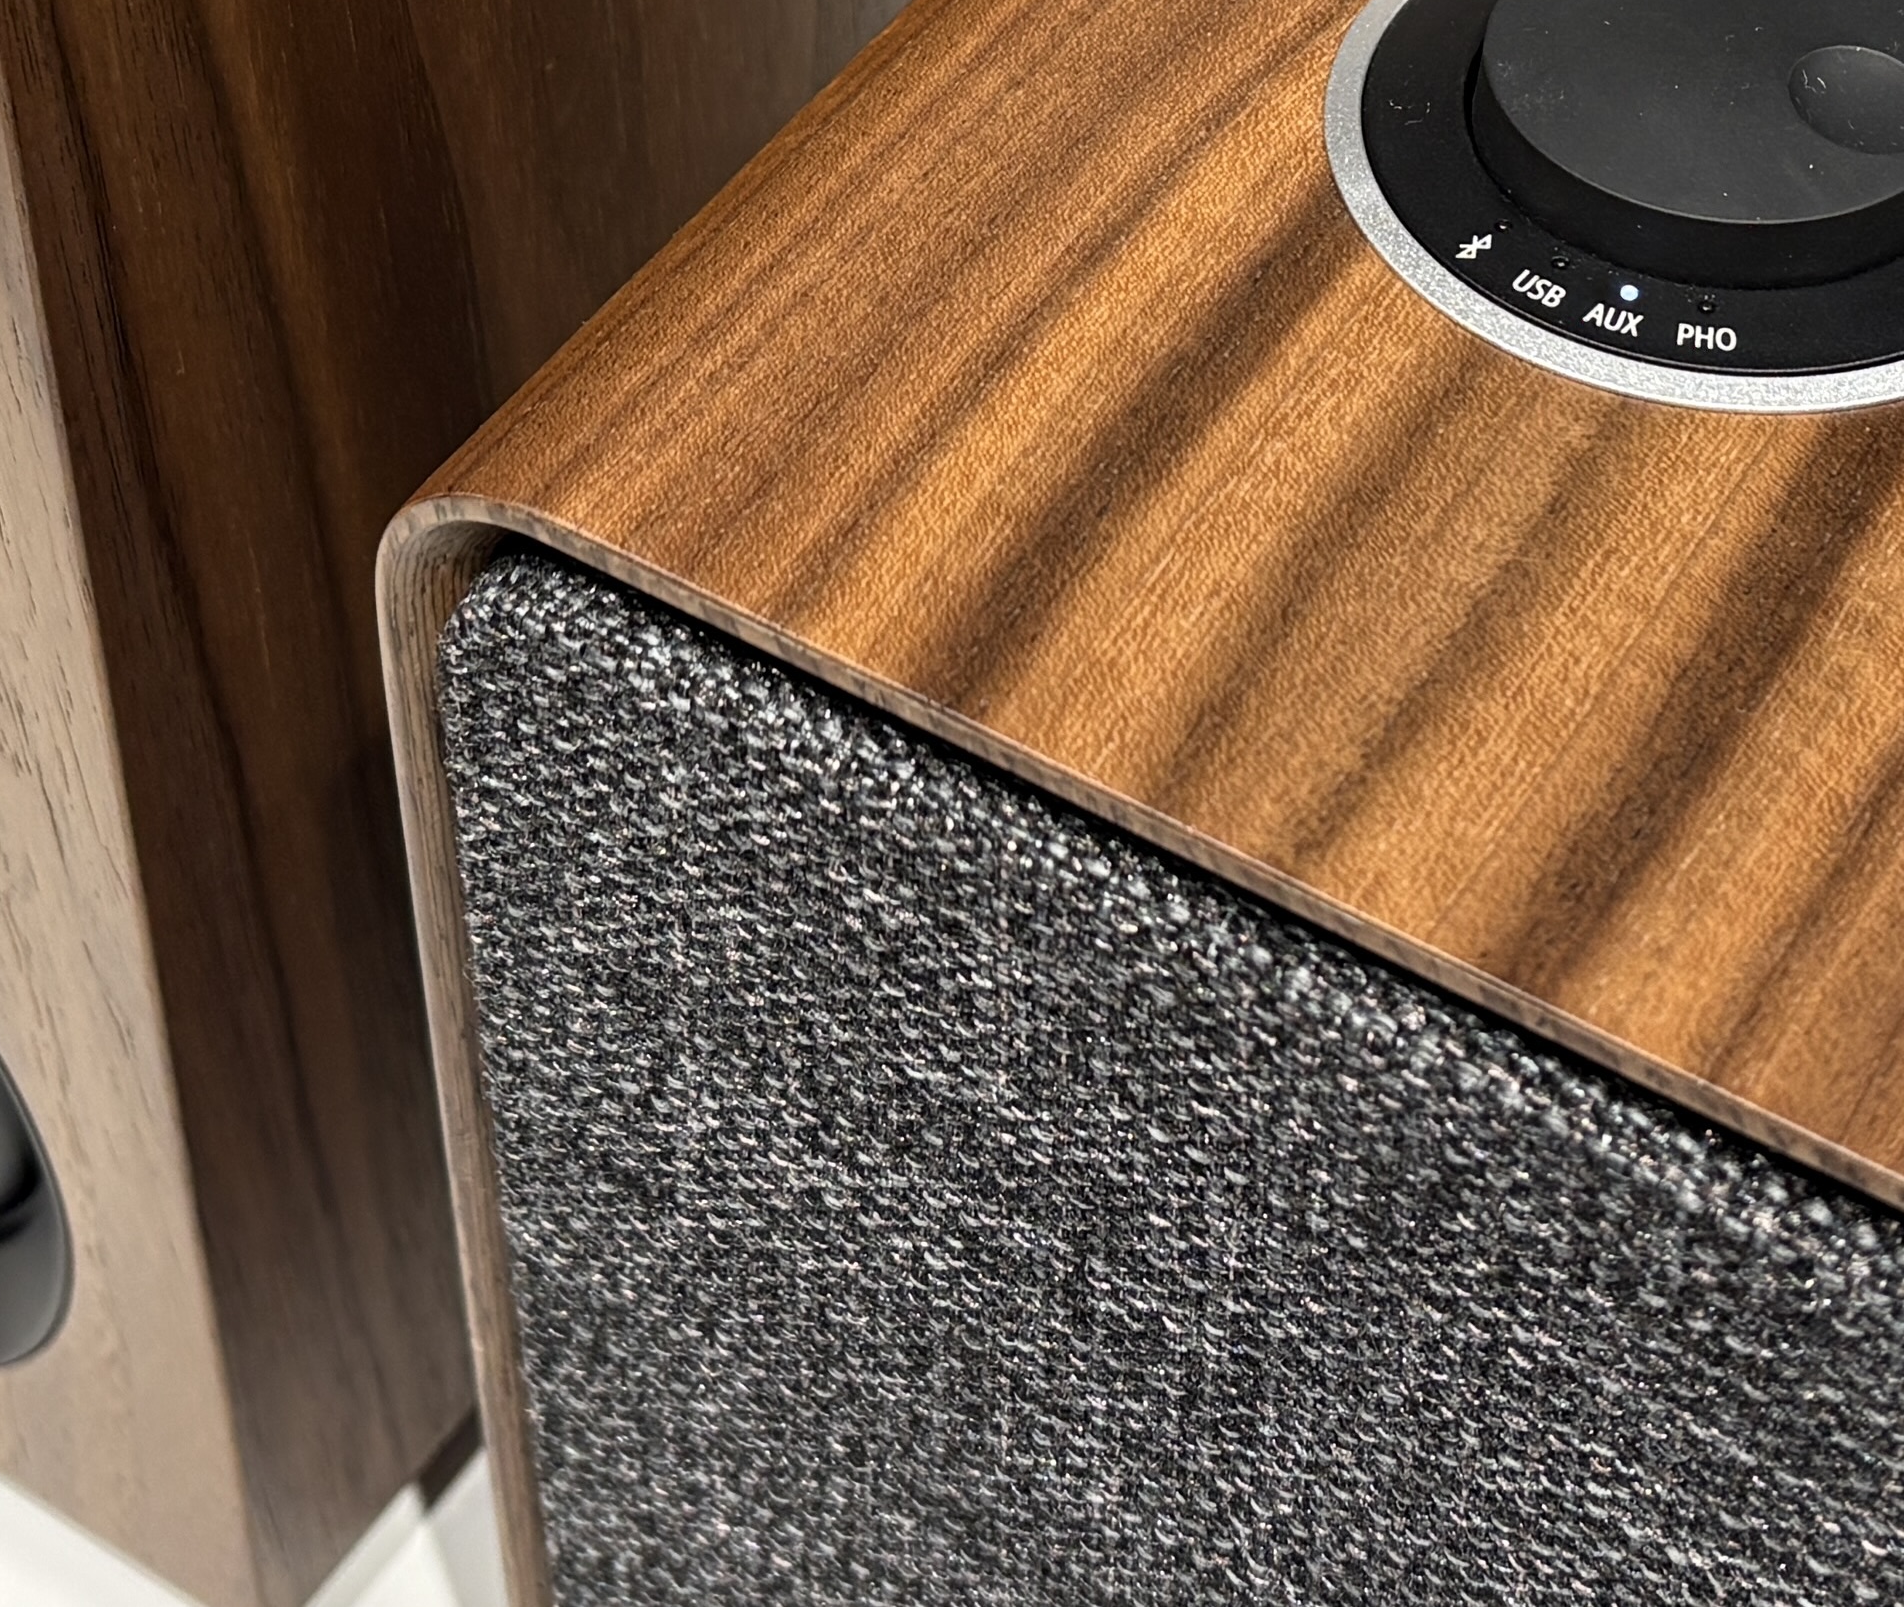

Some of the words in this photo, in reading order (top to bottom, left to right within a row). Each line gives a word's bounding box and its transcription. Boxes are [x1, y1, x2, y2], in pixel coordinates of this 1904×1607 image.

[1509, 266, 1567, 309] USB
[1582, 300, 1645, 338] AUX
[1675, 322, 1738, 353] PHO
